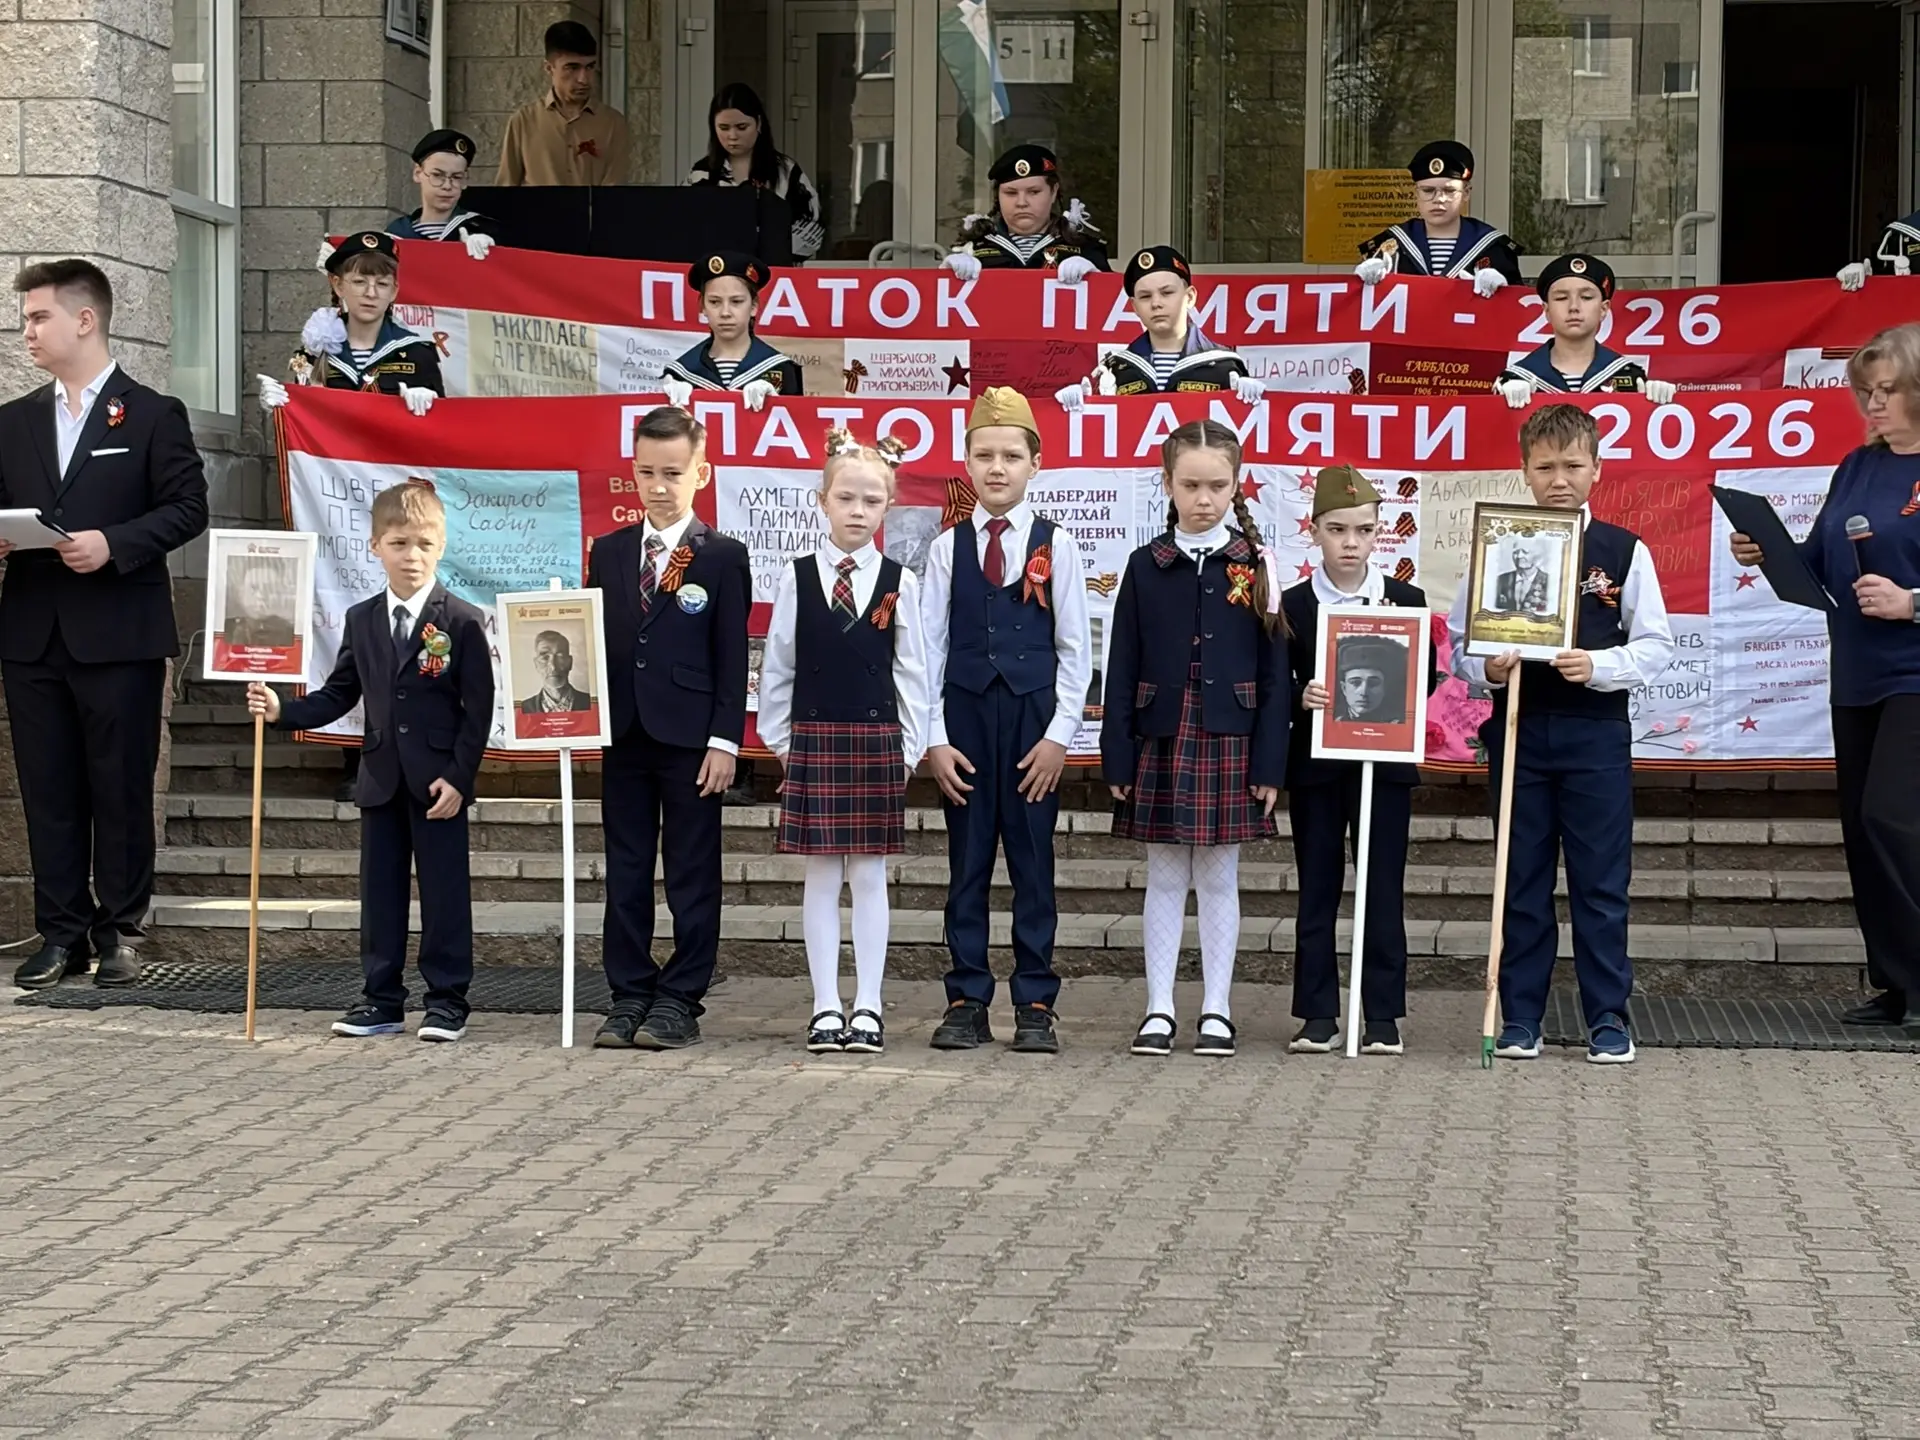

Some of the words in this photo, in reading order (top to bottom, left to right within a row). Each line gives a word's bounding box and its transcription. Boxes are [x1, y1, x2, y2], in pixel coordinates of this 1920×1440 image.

[999, 37, 1014, 60] 5
[1042, 38, 1067, 60] 11
[641, 270, 981, 329] ПАТОК
[1517, 294, 1722, 346] 226
[492, 315, 588, 348] НИКОЛАЕВ
[870, 352, 937, 365] ЩЕРБАКОВ
[1246, 356, 1355, 379] ШАРАПОВ
[1405, 360, 1470, 374] ГАББАСОВ
[879, 366, 935, 378] МИХАИЛ
[861, 380, 944, 392] ГРИГОРЬЕВИЧ
[1589, 398, 1816, 461] 2026
[453, 477, 549, 520] Закиров
[739, 486, 818, 508] АХМЕТО
[1031, 506, 1111, 522] БДУЛХАЙ
